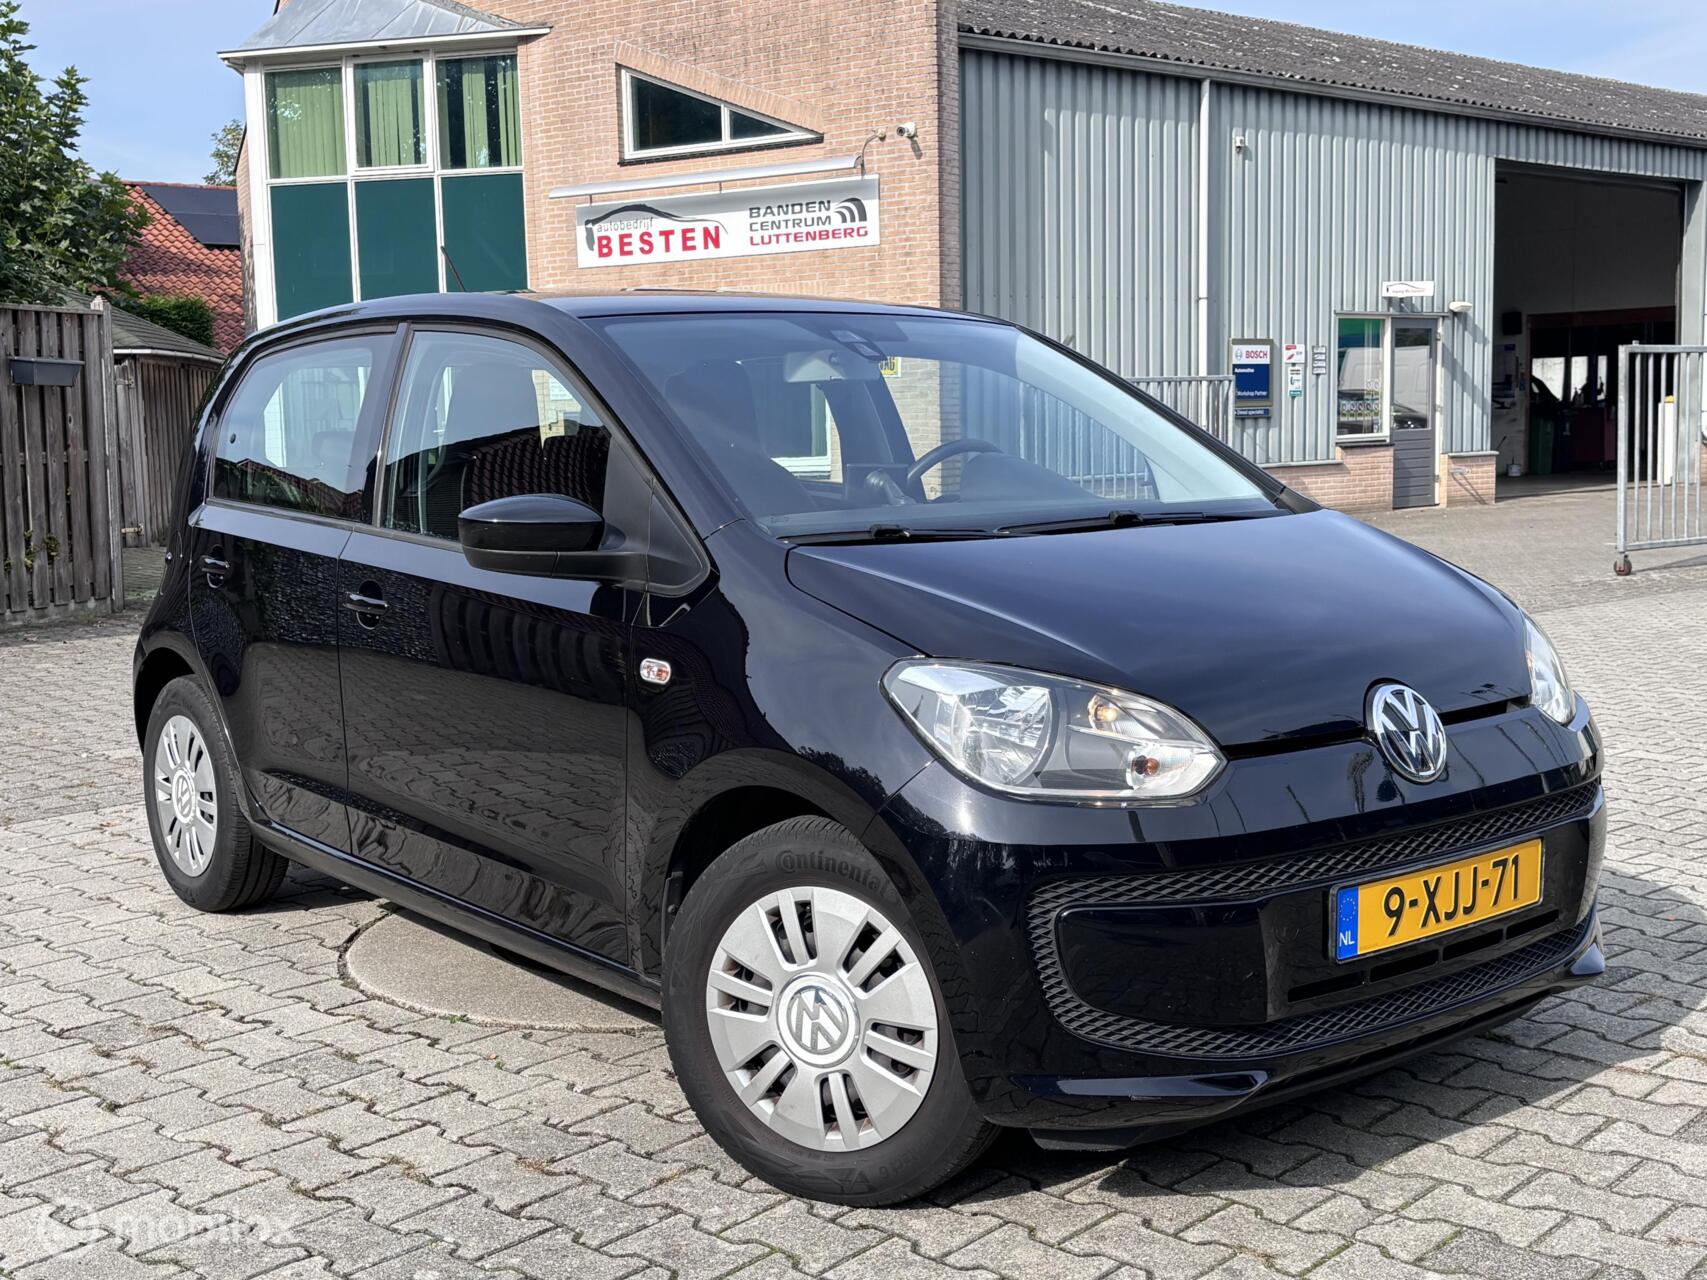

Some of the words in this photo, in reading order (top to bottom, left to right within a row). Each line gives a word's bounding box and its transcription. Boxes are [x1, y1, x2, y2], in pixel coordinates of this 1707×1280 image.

[749, 200, 831, 219] BANDEN
[597, 217, 654, 232] autobedrijf
[749, 215, 831, 232] CENTRUM
[597, 225, 720, 258] BESTEN
[749, 226, 868, 246] LUTTENBERG
[1245, 350, 1268, 359] BOSCH
[776, 850, 889, 895] Continental
[1383, 854, 1519, 937] 9-XJJ-71
[1339, 932, 1354, 947] NL
